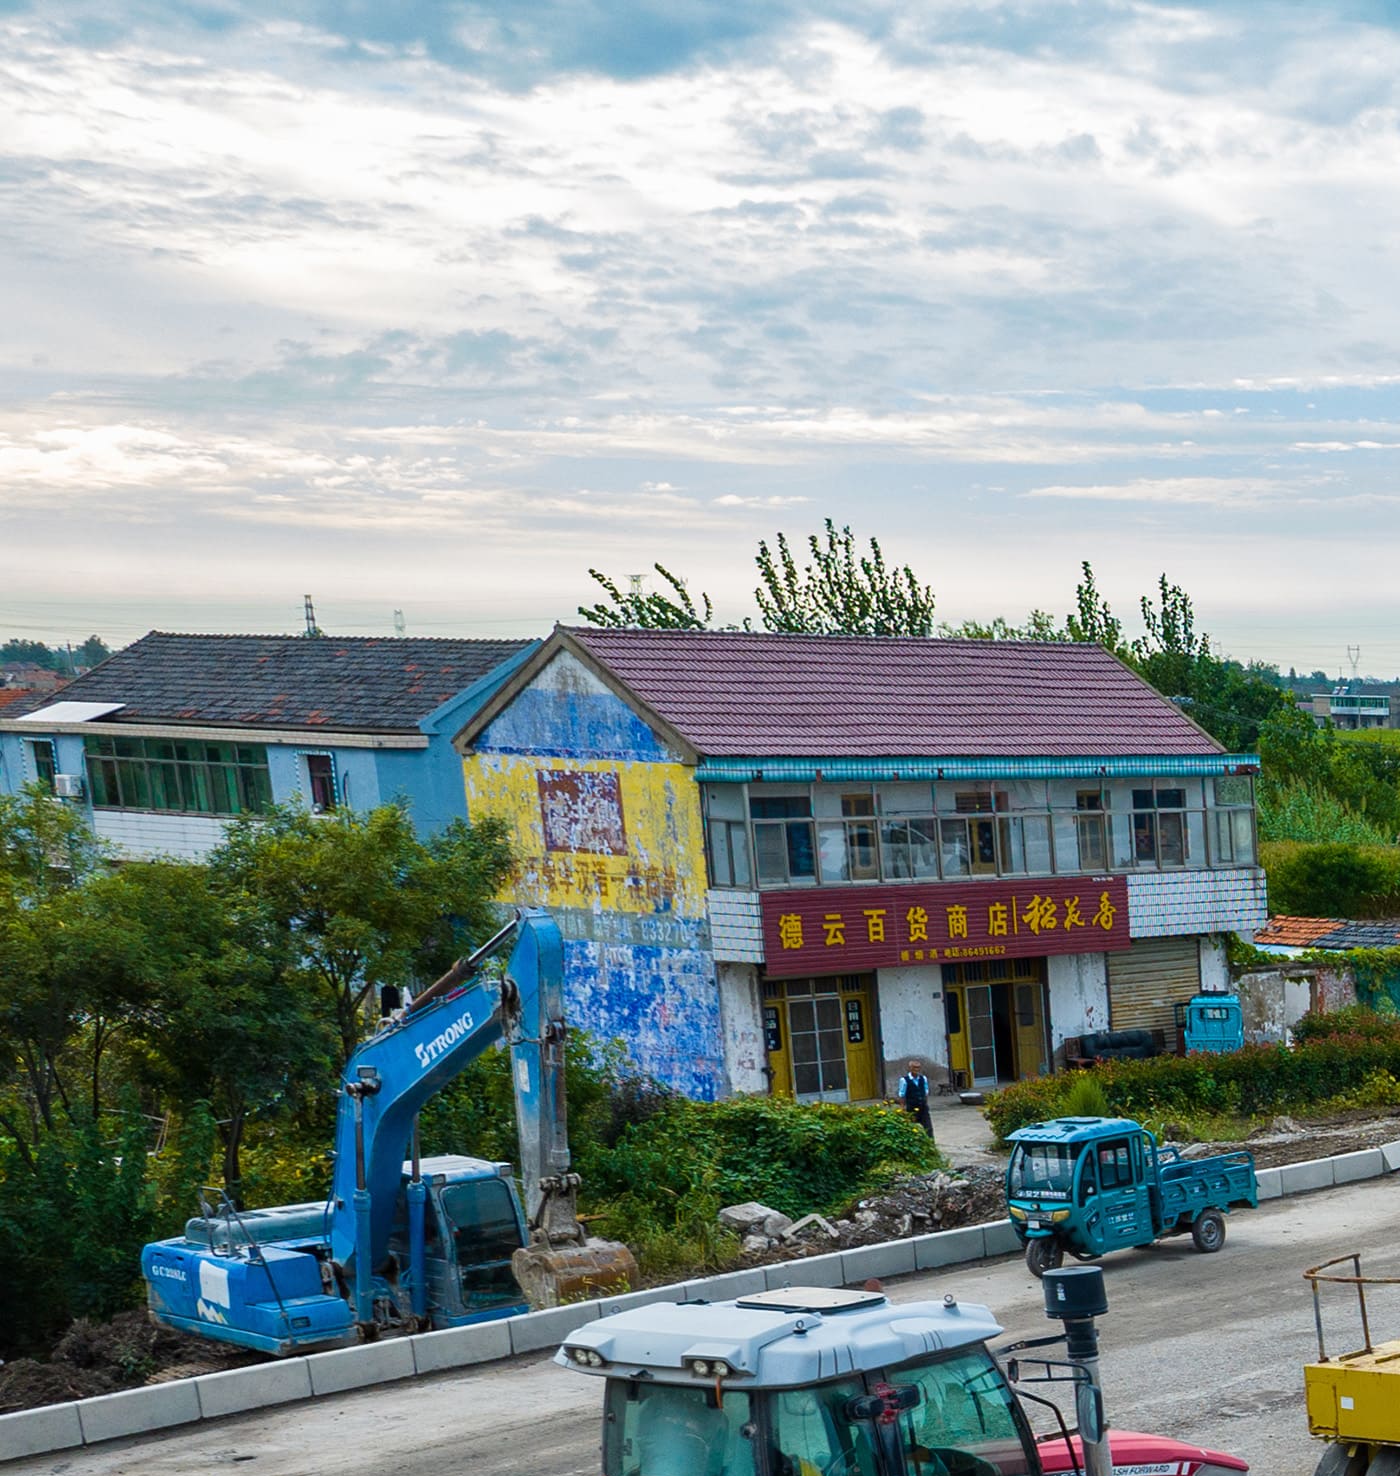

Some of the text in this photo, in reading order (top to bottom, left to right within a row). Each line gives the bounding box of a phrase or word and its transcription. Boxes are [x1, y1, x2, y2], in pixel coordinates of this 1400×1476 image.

[778, 901, 1010, 951] 德云百货商店
[414, 1011, 474, 1069] STRONG
[1130, 1464, 1170, 1474] FORWARD
